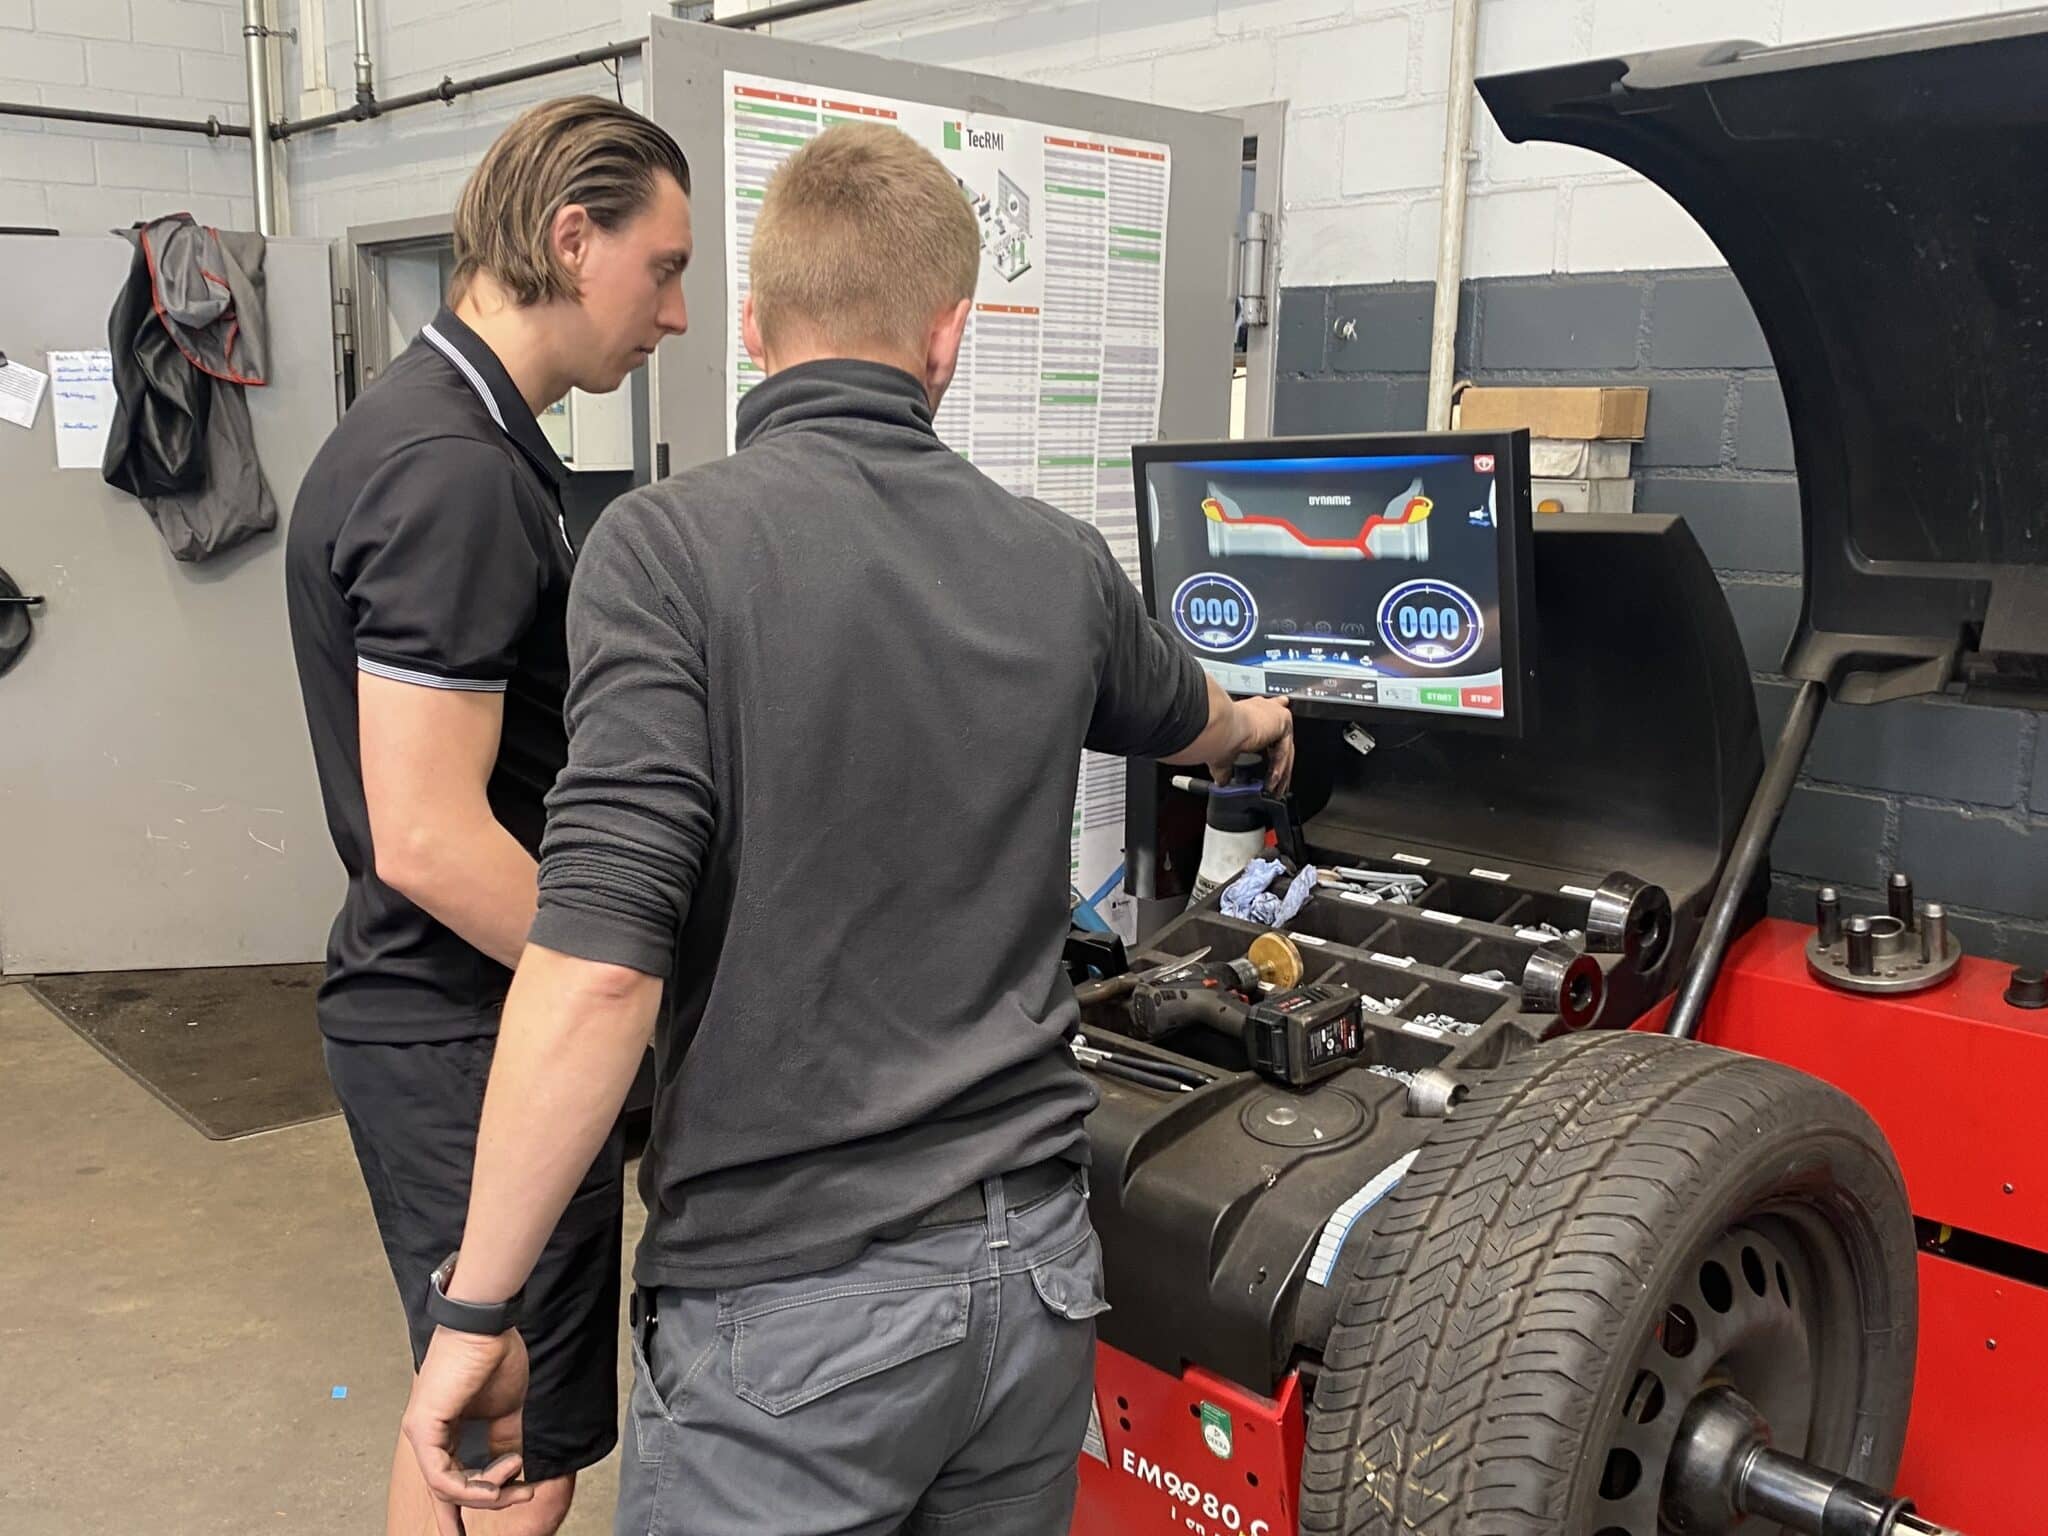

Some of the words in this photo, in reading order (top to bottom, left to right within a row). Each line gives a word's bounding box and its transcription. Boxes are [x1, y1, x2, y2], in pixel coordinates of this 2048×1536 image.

[966, 128, 1004, 152] TecRMI
[1308, 495, 1351, 506] DYNAMIC
[1190, 597, 1240, 627] 000
[1398, 605, 1460, 641] 000
[1426, 692, 1453, 703] START
